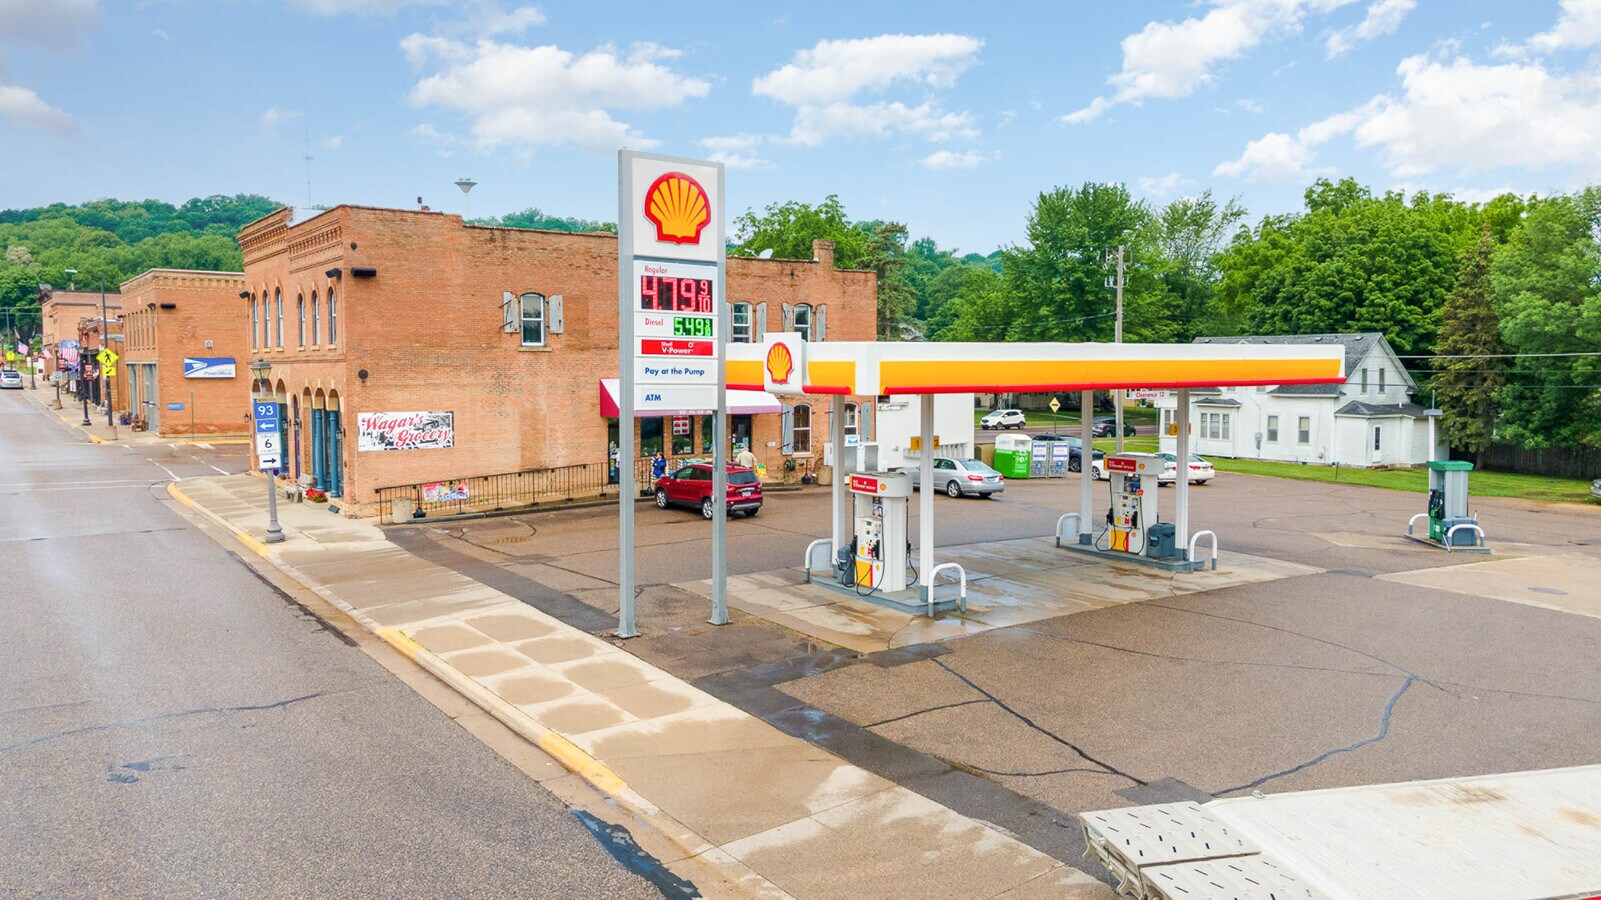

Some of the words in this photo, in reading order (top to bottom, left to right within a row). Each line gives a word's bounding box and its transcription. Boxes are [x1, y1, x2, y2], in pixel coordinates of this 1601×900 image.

[644, 265, 668, 275] Regular
[645, 317, 664, 326] Diesel
[645, 367, 659, 376] Pay
[670, 367, 682, 375] the
[684, 368, 705, 376] Pump
[257, 405, 274, 416] 93
[361, 413, 424, 434] Wagar's
[395, 429, 452, 447] Grocery
[264, 439, 273, 449] 6
